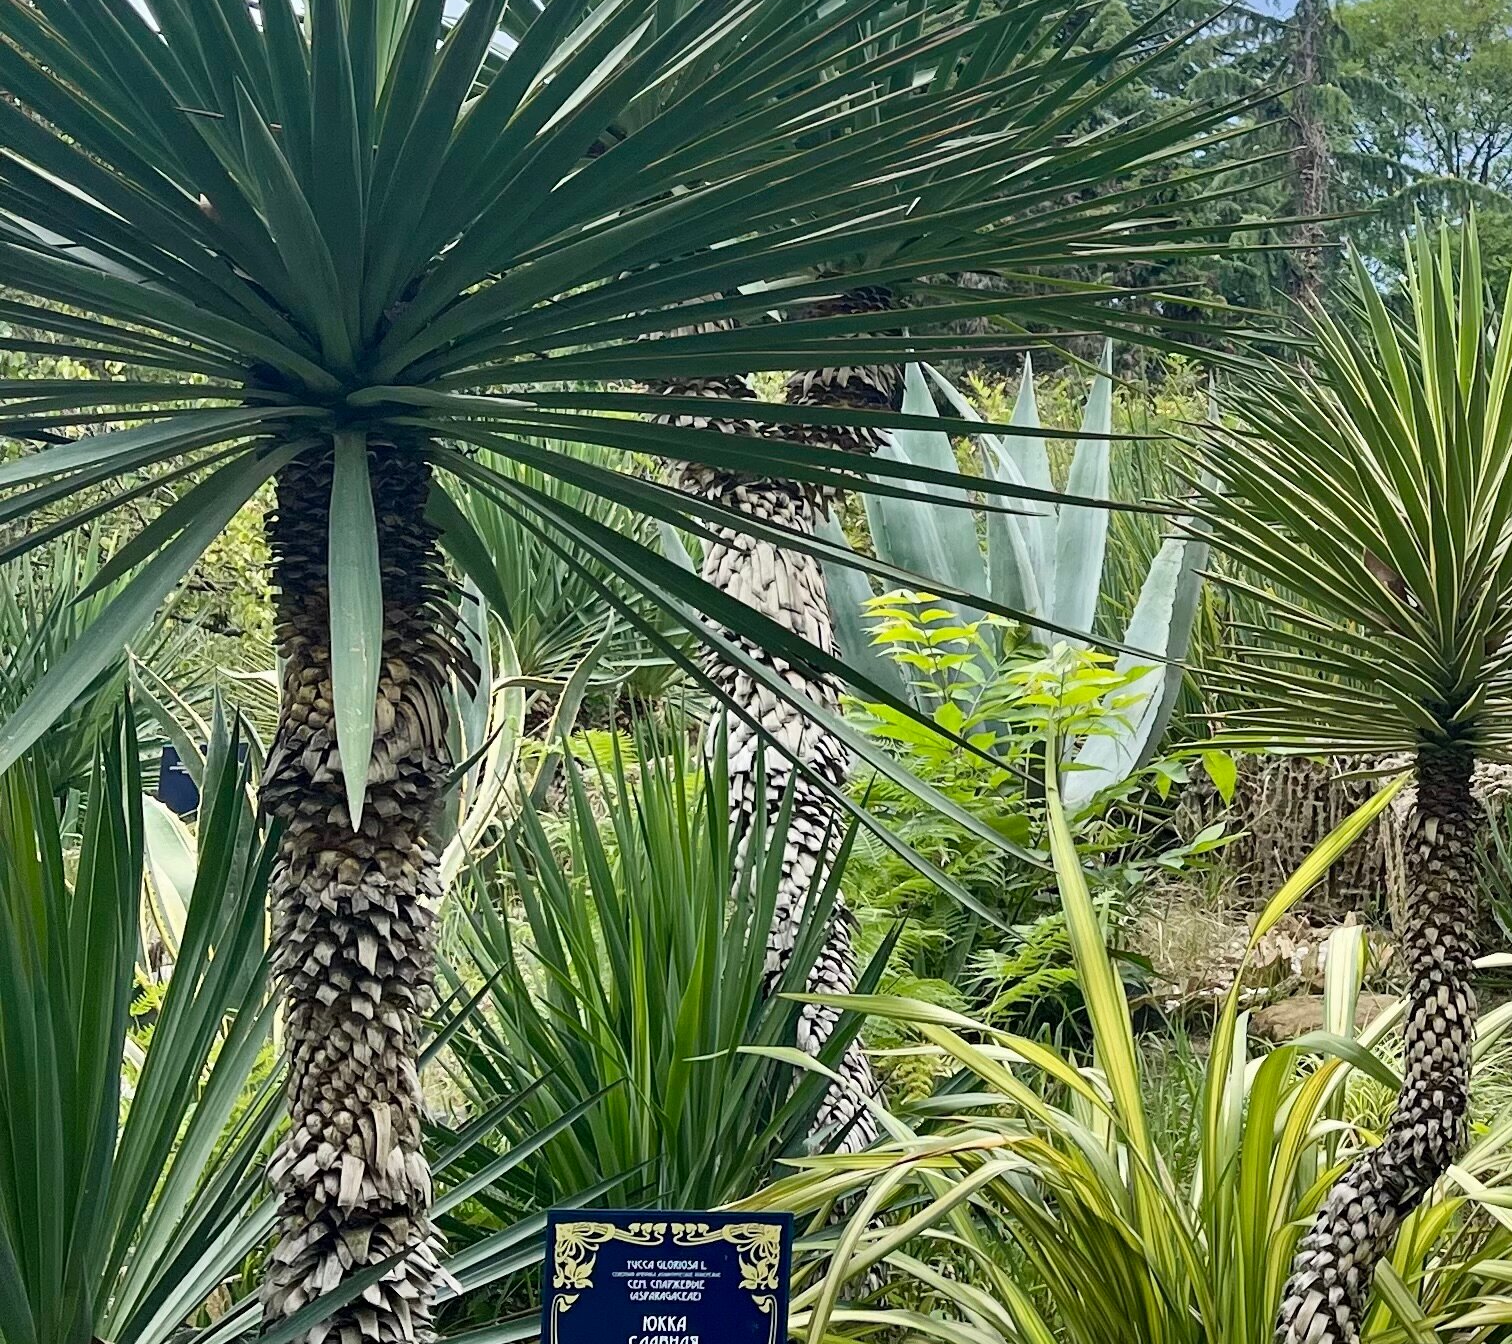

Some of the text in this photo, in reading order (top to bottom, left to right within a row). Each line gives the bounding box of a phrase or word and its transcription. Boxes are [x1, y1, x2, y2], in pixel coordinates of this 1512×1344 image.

[656, 1260, 699, 1270] GLORIOSA
[650, 1279, 705, 1290] СПАРЖЕВЫЕ
[642, 1315, 687, 1332] ЮККА
